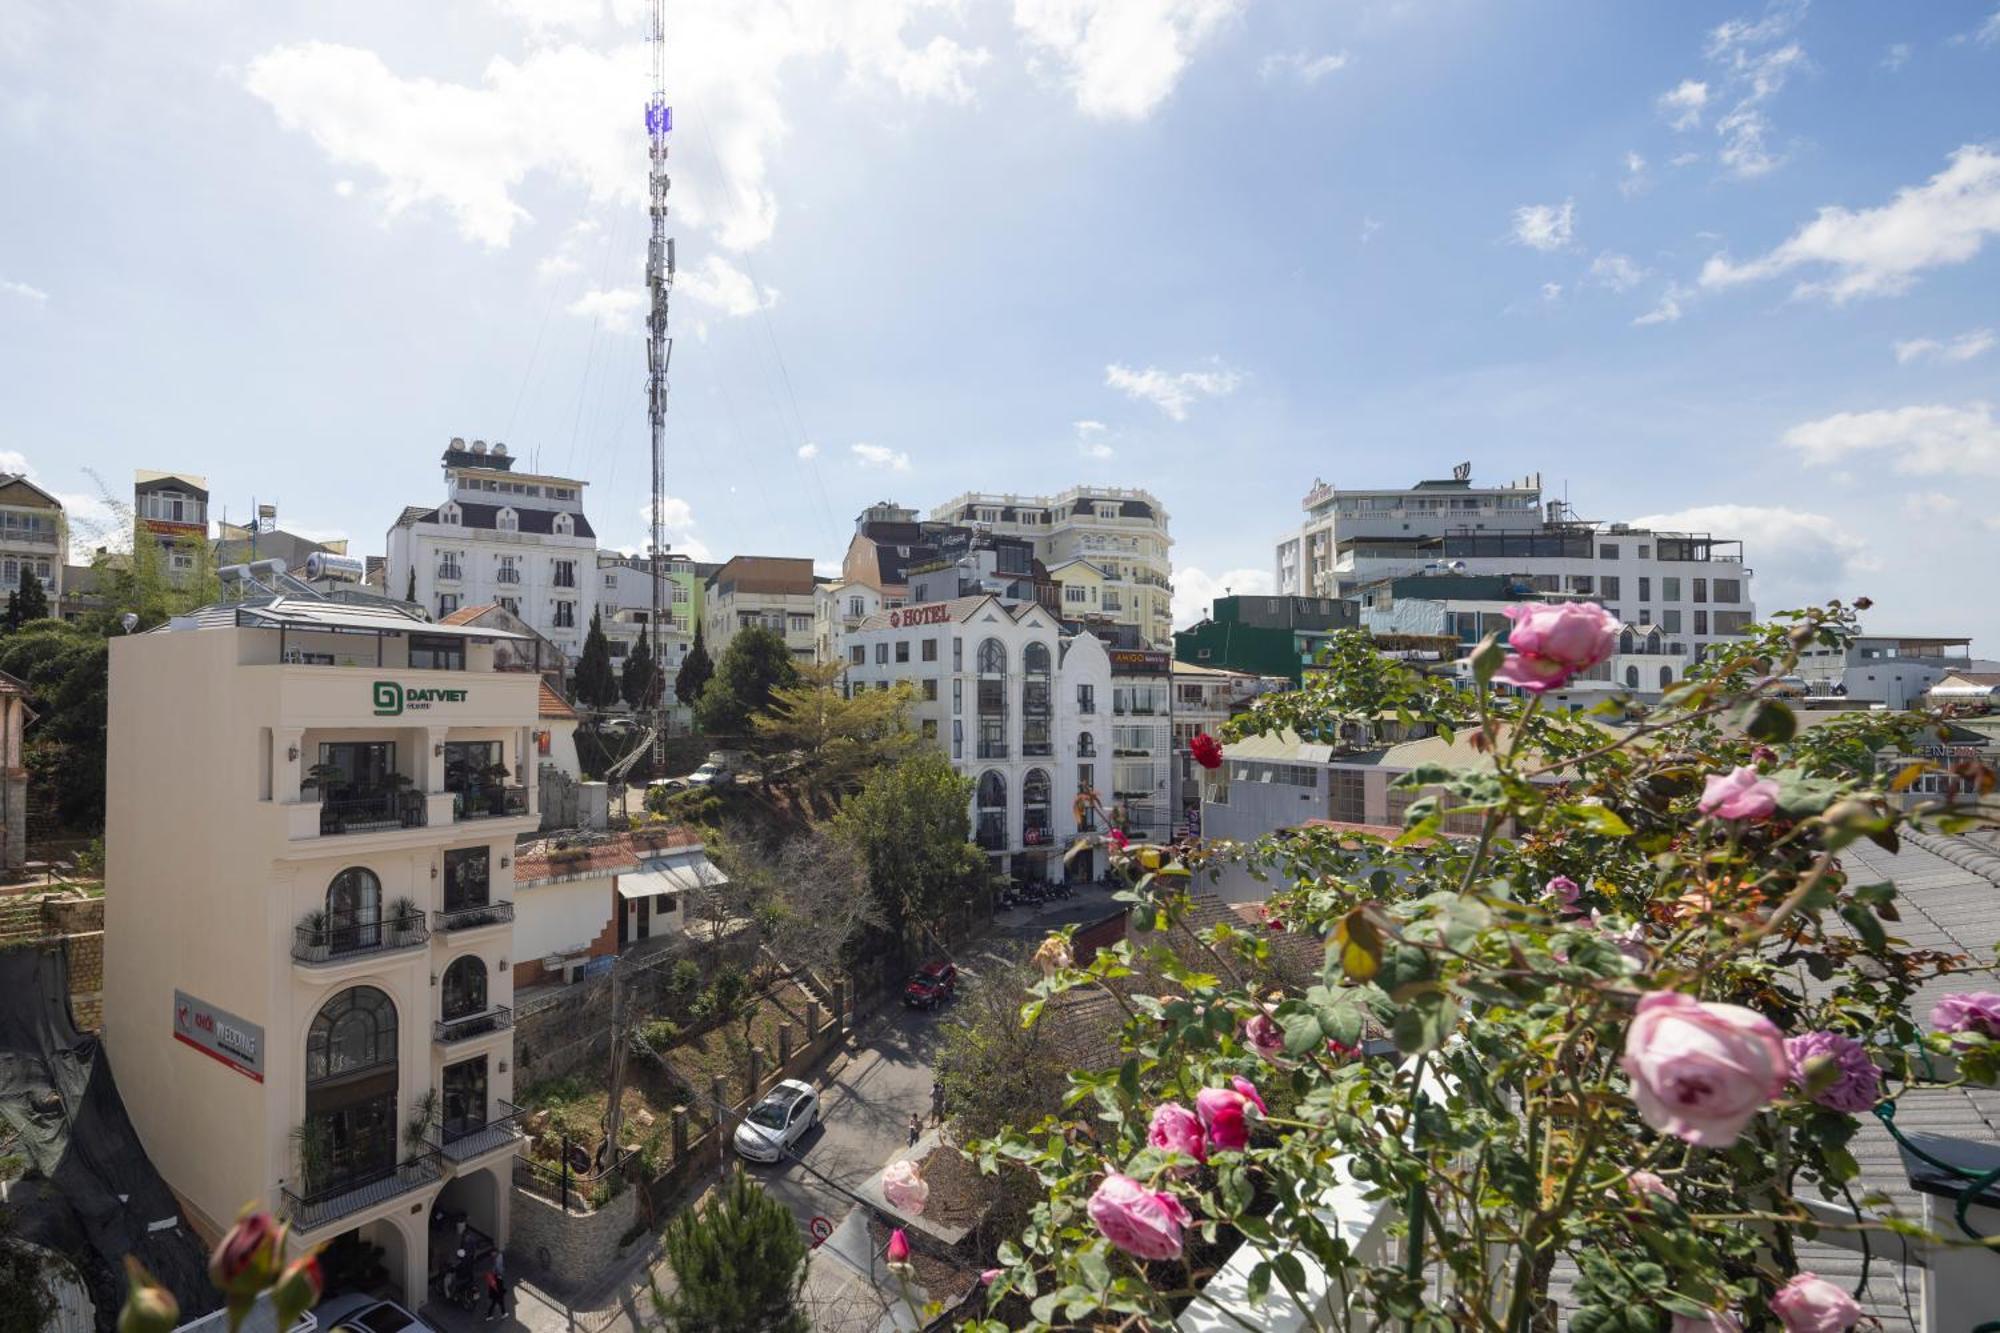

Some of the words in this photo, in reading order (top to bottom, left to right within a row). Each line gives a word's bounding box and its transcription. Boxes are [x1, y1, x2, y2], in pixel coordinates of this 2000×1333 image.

[903, 604, 950, 627] HOTEL
[1115, 653, 1144, 663] AMIGO
[406, 688, 468, 702] DATVIET
